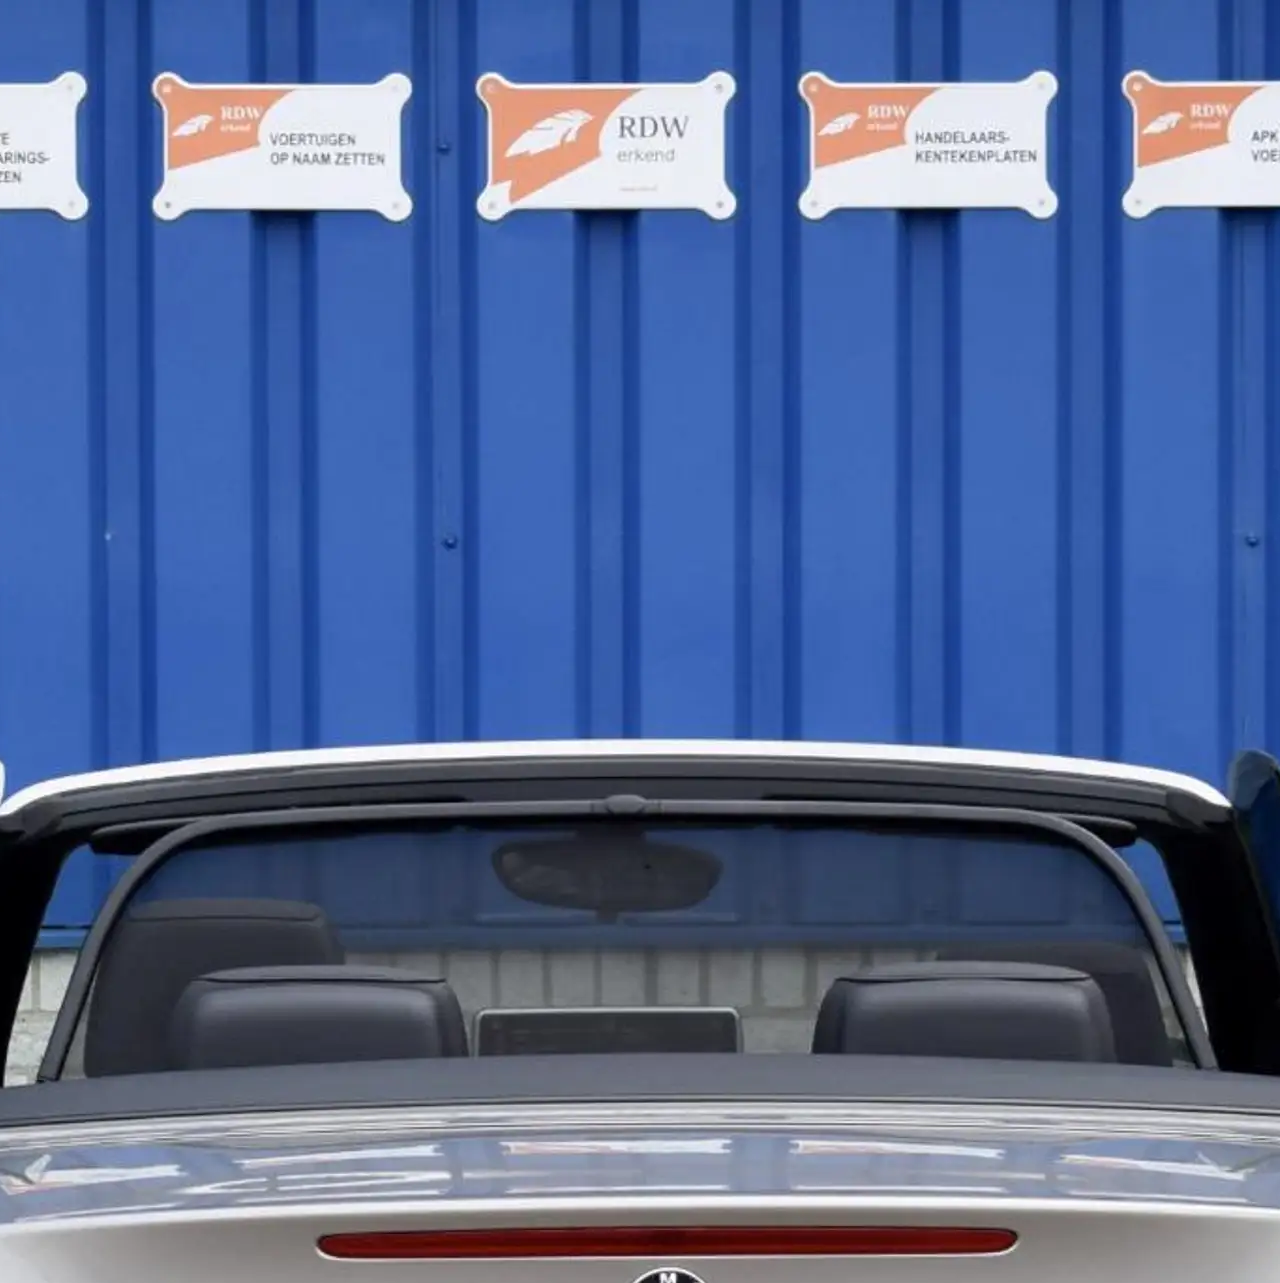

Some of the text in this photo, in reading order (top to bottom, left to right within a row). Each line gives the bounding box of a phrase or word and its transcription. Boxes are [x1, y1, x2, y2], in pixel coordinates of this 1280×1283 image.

[220, 105, 263, 120] RDW
[867, 104, 910, 119] RDW
[1190, 103, 1232, 118] RDW
[618, 115, 689, 139] RDW
[270, 133, 357, 147] VOERTUIGEN
[915, 131, 1010, 145] HANDELAARS-
[1251, 129, 1279, 143] APK
[270, 152, 386, 166] OP NAAM ZETTEN
[616, 147, 676, 163] erkend
[915, 149, 1038, 163] KENTEKENPLATEN
